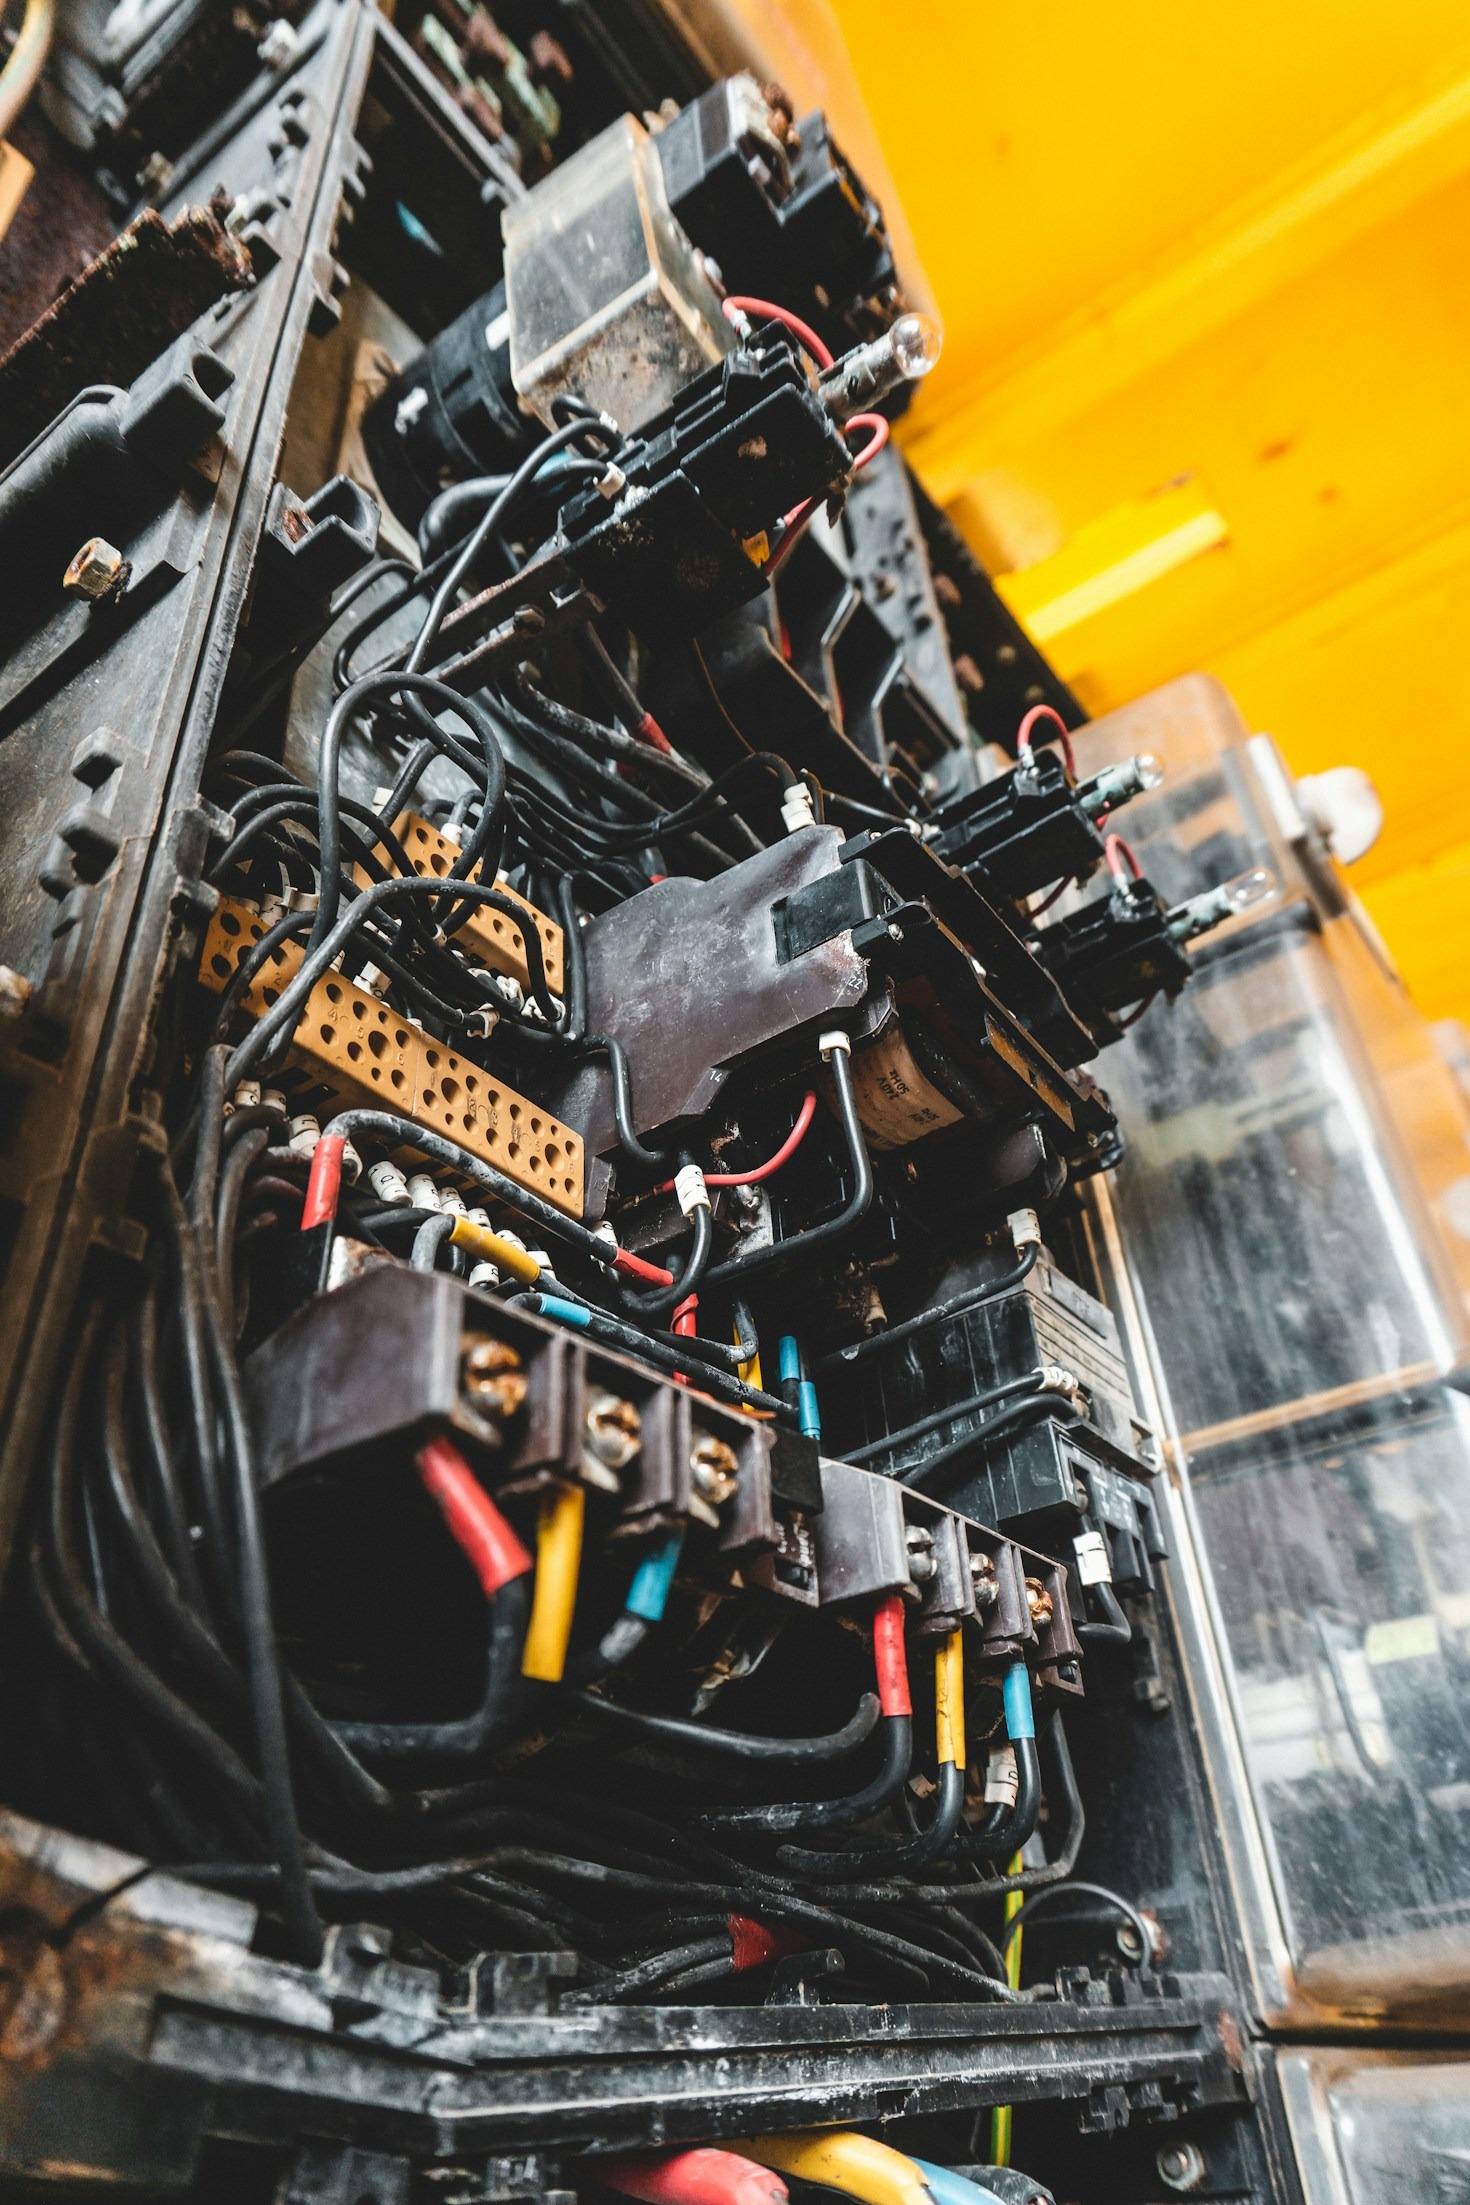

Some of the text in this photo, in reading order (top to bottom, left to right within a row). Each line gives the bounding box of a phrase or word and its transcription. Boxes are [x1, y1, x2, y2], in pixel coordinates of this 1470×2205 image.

[848, 976, 863, 990] 22
[709, 1070, 723, 1082] 14
[889, 1069, 910, 1095] 50Hz
[877, 1076, 900, 1100] 240V
